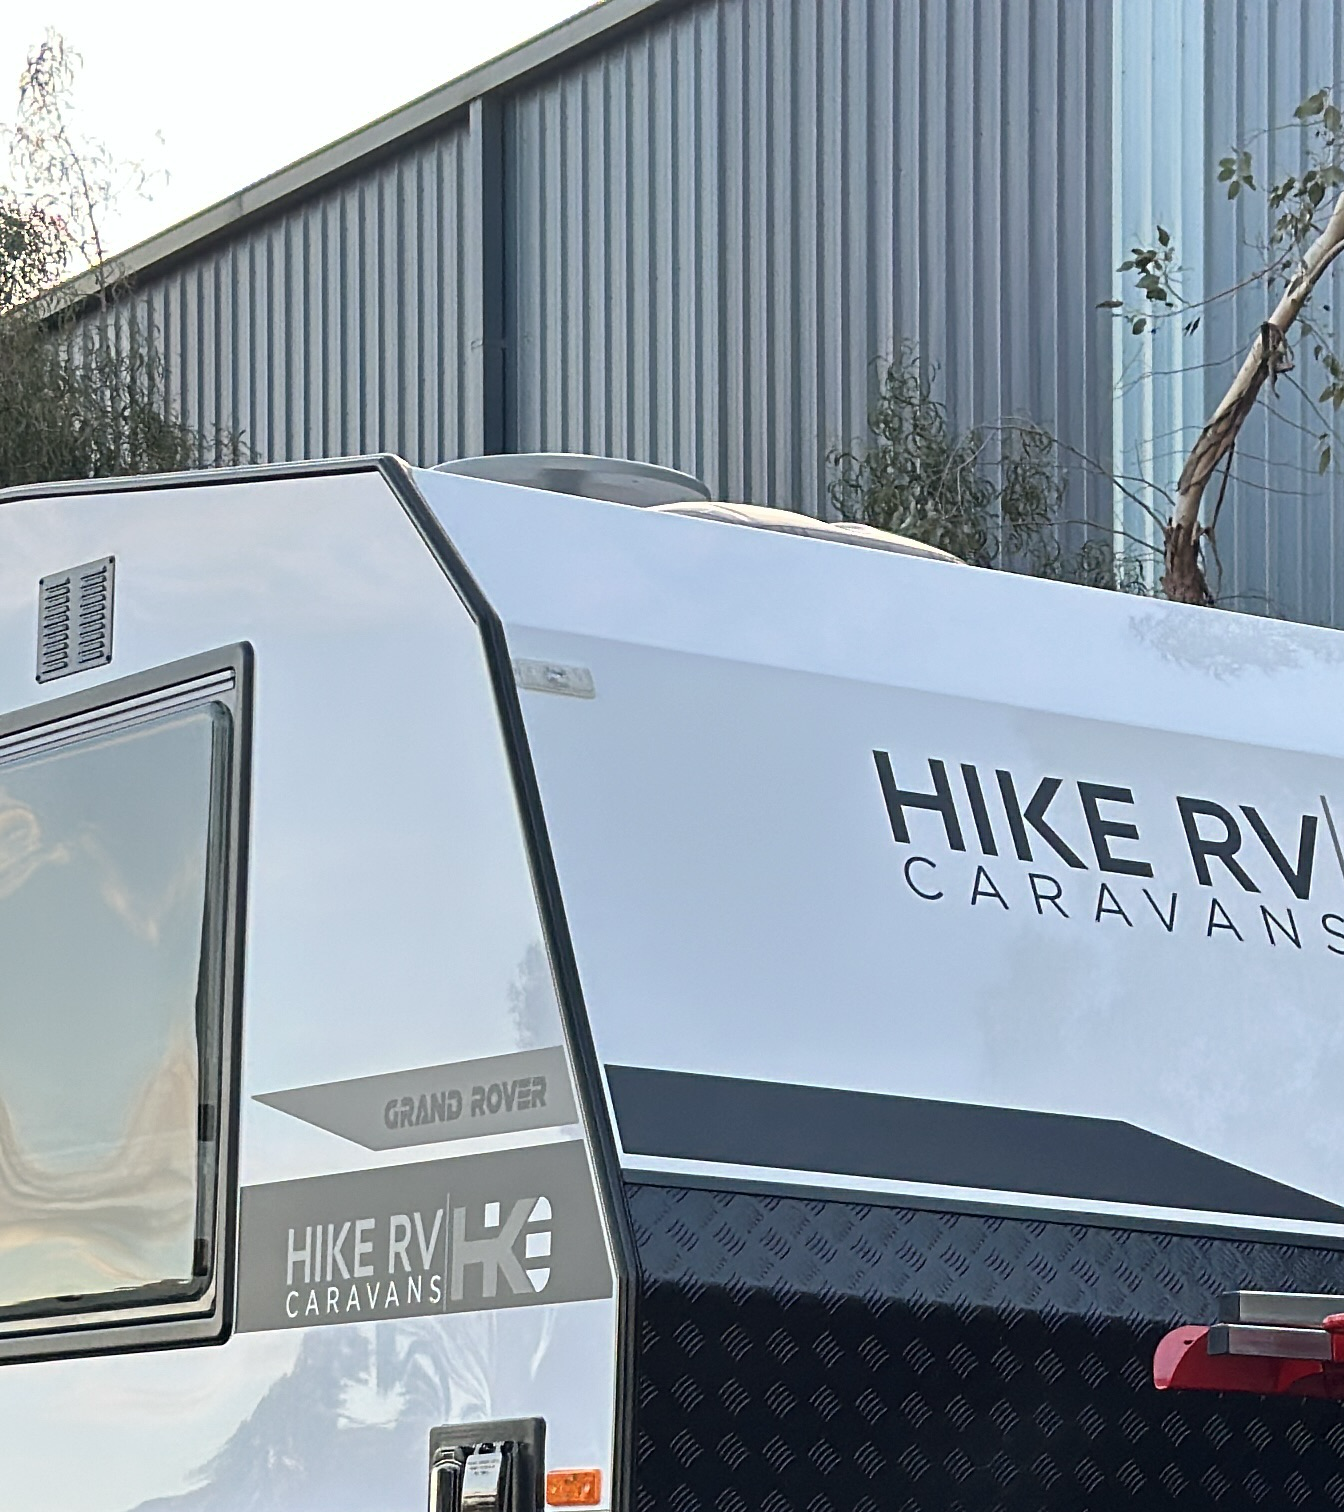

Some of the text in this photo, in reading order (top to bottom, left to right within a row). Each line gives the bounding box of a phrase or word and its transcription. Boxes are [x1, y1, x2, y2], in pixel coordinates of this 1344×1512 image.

[872, 749, 1319, 901] HIKE RV
[384, 1075, 547, 1130] GRAND ROVER
[286, 1209, 444, 1286] HIKE RV
[286, 1273, 442, 1318] CARAVANS
